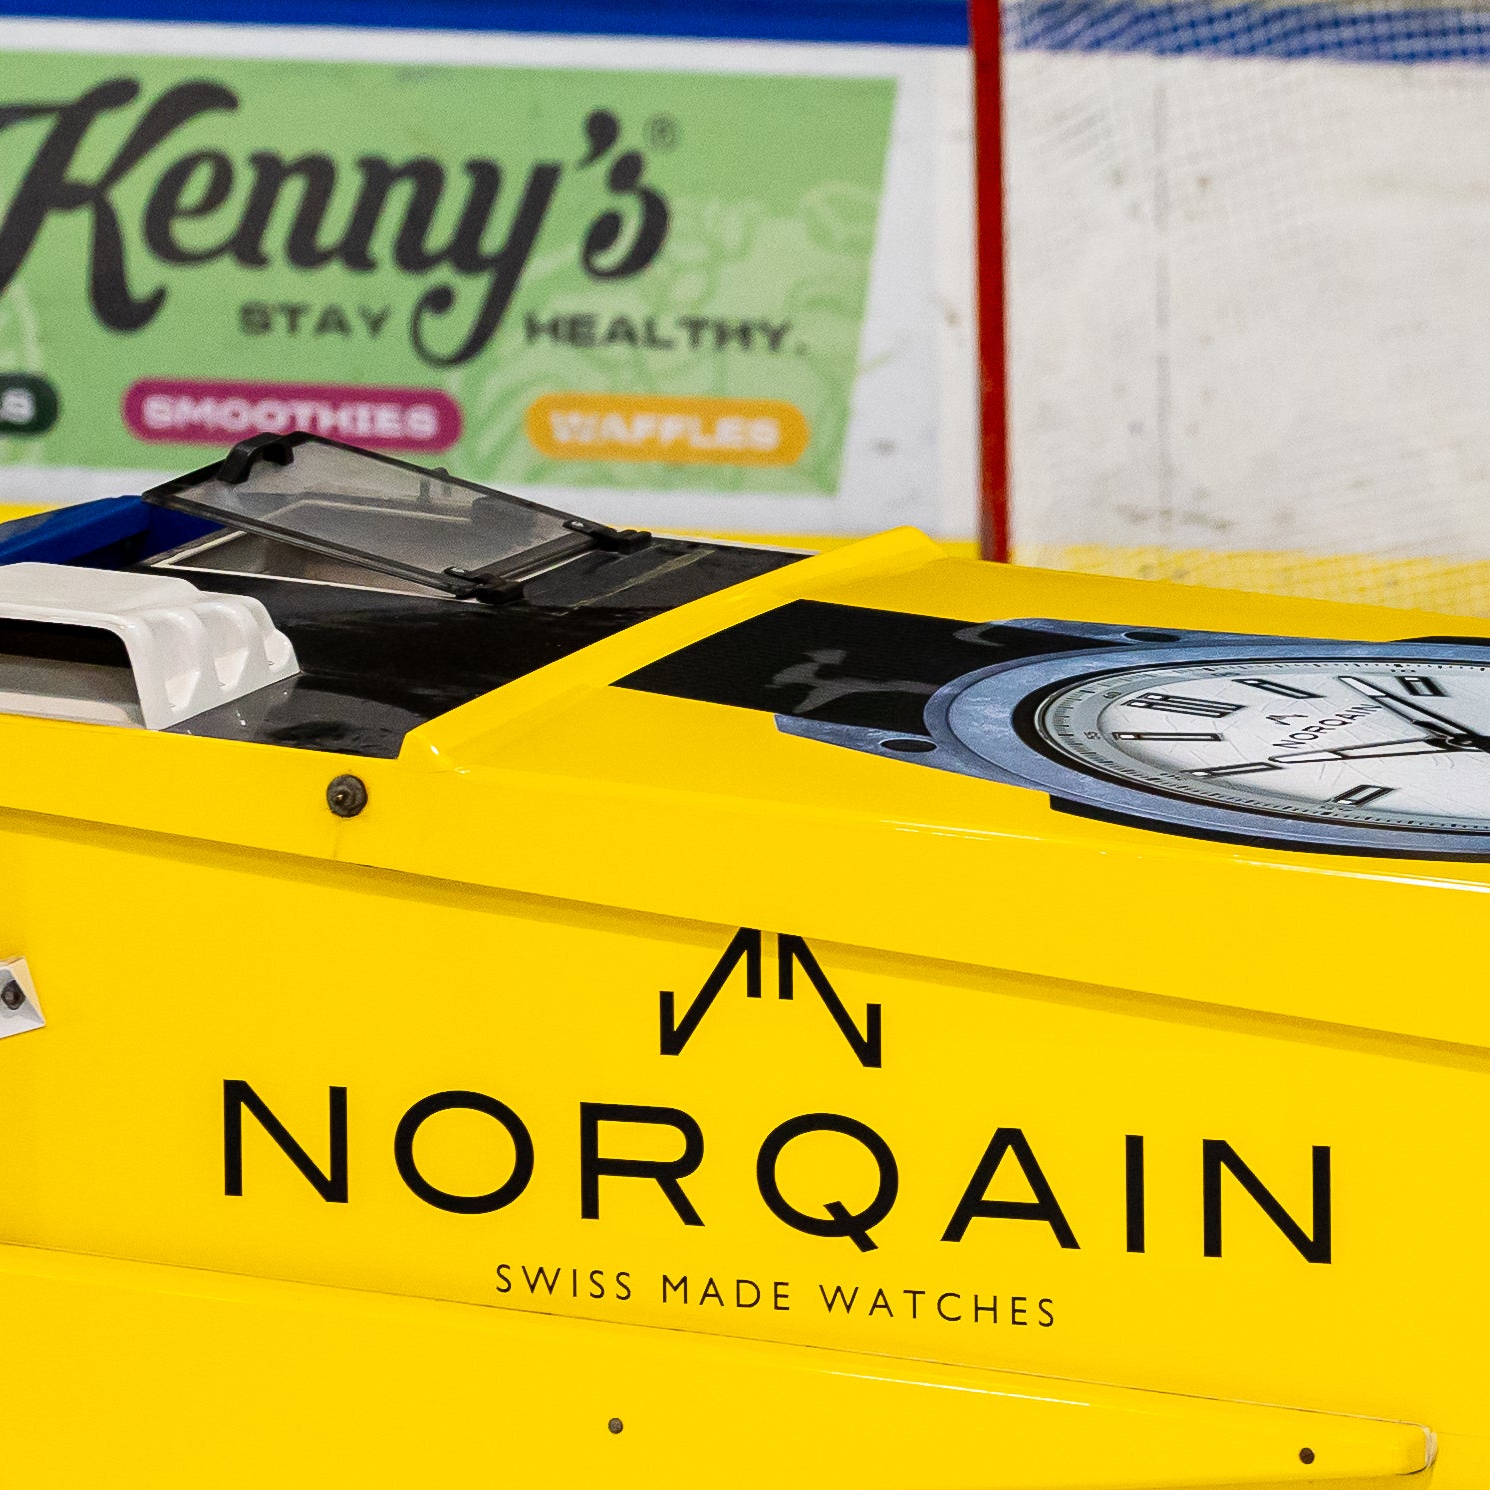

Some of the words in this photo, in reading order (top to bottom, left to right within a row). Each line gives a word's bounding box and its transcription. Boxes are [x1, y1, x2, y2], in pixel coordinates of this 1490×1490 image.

[239, 300, 391, 341] STAY
[523, 308, 807, 357] HEALTHY.
[141, 394, 441, 439] SMOOTHIES
[549, 410, 780, 450] WAFFLES
[1272, 703, 1383, 749] NORQAIN
[223, 1079, 1332, 1265] NORQAIN
[496, 1263, 631, 1301] SWISS
[662, 1275, 790, 1312] MADE
[818, 1284, 1054, 1328] WATCHES
